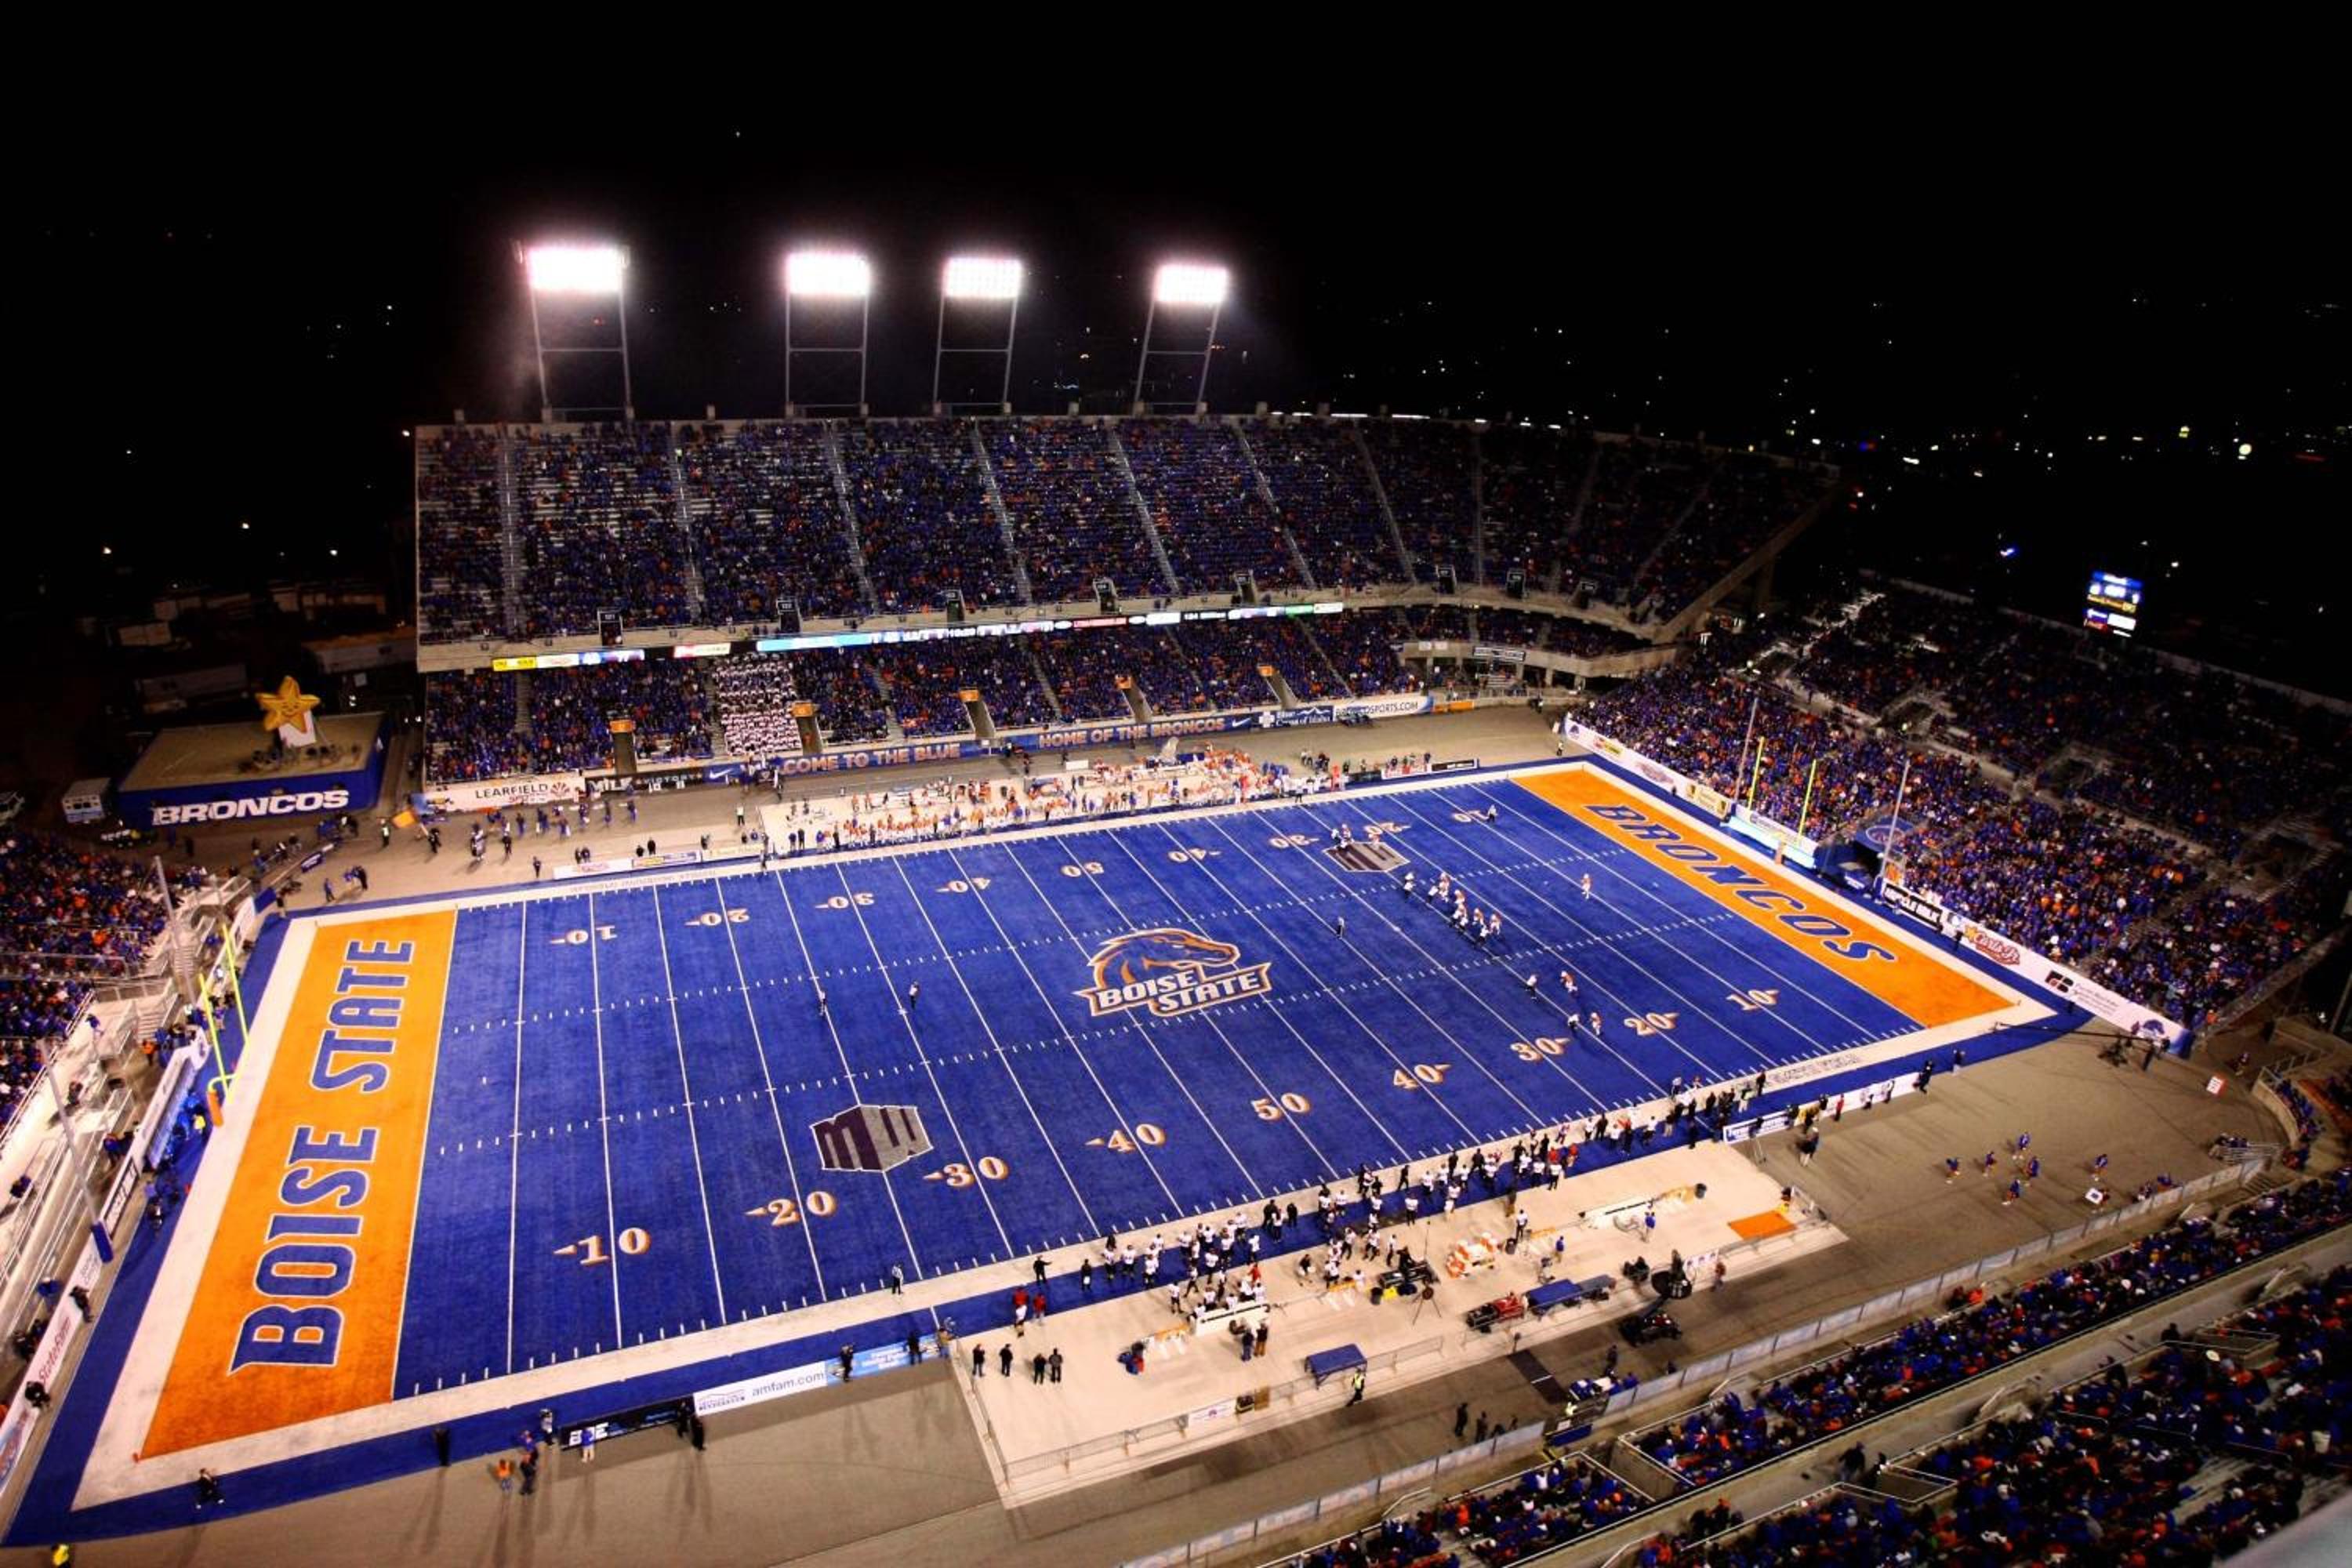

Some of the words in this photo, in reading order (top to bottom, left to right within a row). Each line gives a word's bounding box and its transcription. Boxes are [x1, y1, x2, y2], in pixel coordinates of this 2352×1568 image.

[1336, 700, 1418, 717] BROSPORTS.COM
[1039, 730, 1087, 748] HOME
[1091, 728, 1114, 743] OF
[1117, 724, 1148, 740] THE
[1150, 717, 1225, 738] BRONCOS
[845, 752, 869, 768] TO
[873, 747, 909, 765] THE
[915, 743, 961, 761] BLUE
[475, 782, 549, 799] LEARFIELD
[151, 789, 350, 826] BRONCOS
[1584, 804, 1899, 963] BRONCOS
[1099, 969, 1199, 1008] BOISE
[1158, 971, 1261, 1011] STATE
[1726, 989, 1778, 1011] 10
[1624, 1012, 1676, 1036] 20
[1510, 1036, 1565, 1062] 30
[1392, 1062, 1443, 1090] 40
[1251, 1091, 1311, 1122] 50
[1107, 1122, 1167, 1153] 40
[227, 1126, 380, 1377] BOISE
[309, 939, 415, 1094] STATE
[942, 1156, 1010, 1189] 30
[767, 1190, 837, 1227] 20
[579, 1227, 652, 1266] 10
[752, 1372, 824, 1398] amfam.com
